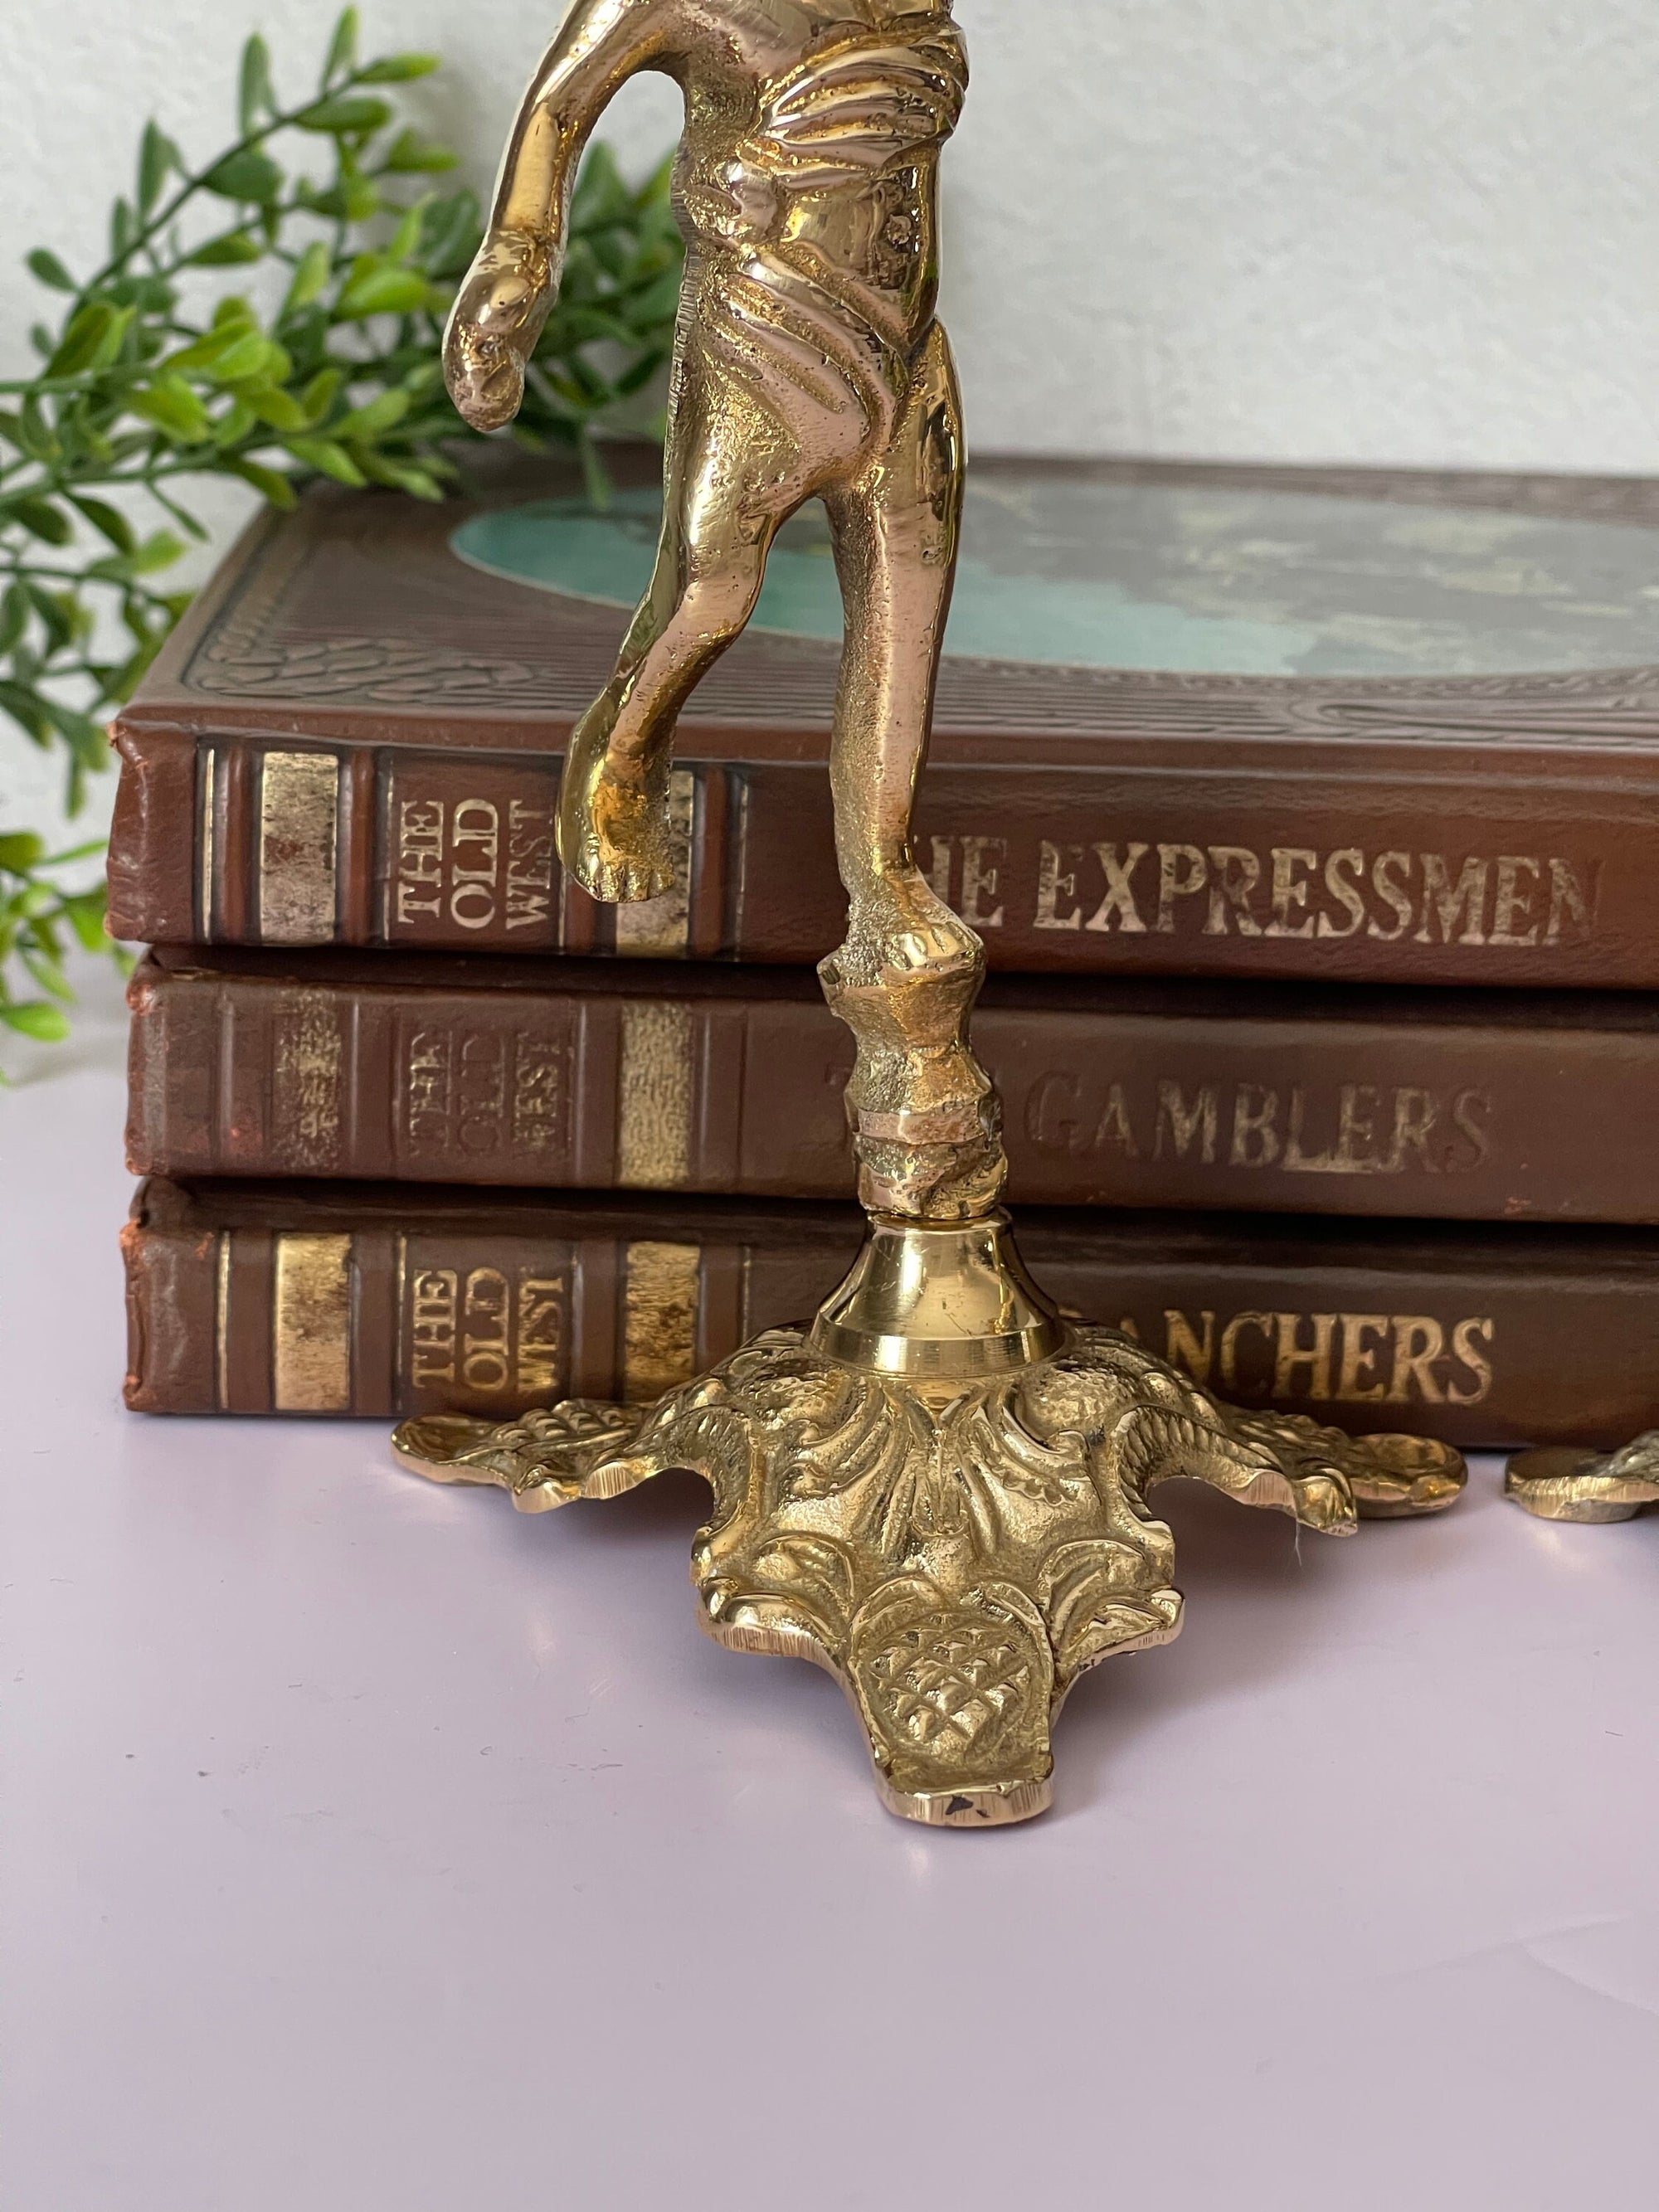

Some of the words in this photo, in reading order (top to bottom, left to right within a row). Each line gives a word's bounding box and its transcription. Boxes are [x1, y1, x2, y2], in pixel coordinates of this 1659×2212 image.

[397, 800, 445, 924] THE
[450, 798, 499, 929] OLD
[505, 799, 553, 930] WEST
[1033, 839, 1607, 946] EXPRESSMEN
[1023, 1070, 1493, 1174] GAMBLERS
[411, 1269, 458, 1388] THE
[463, 1266, 509, 1392] OLD
[1058, 1307, 1493, 1406] NCHERS
